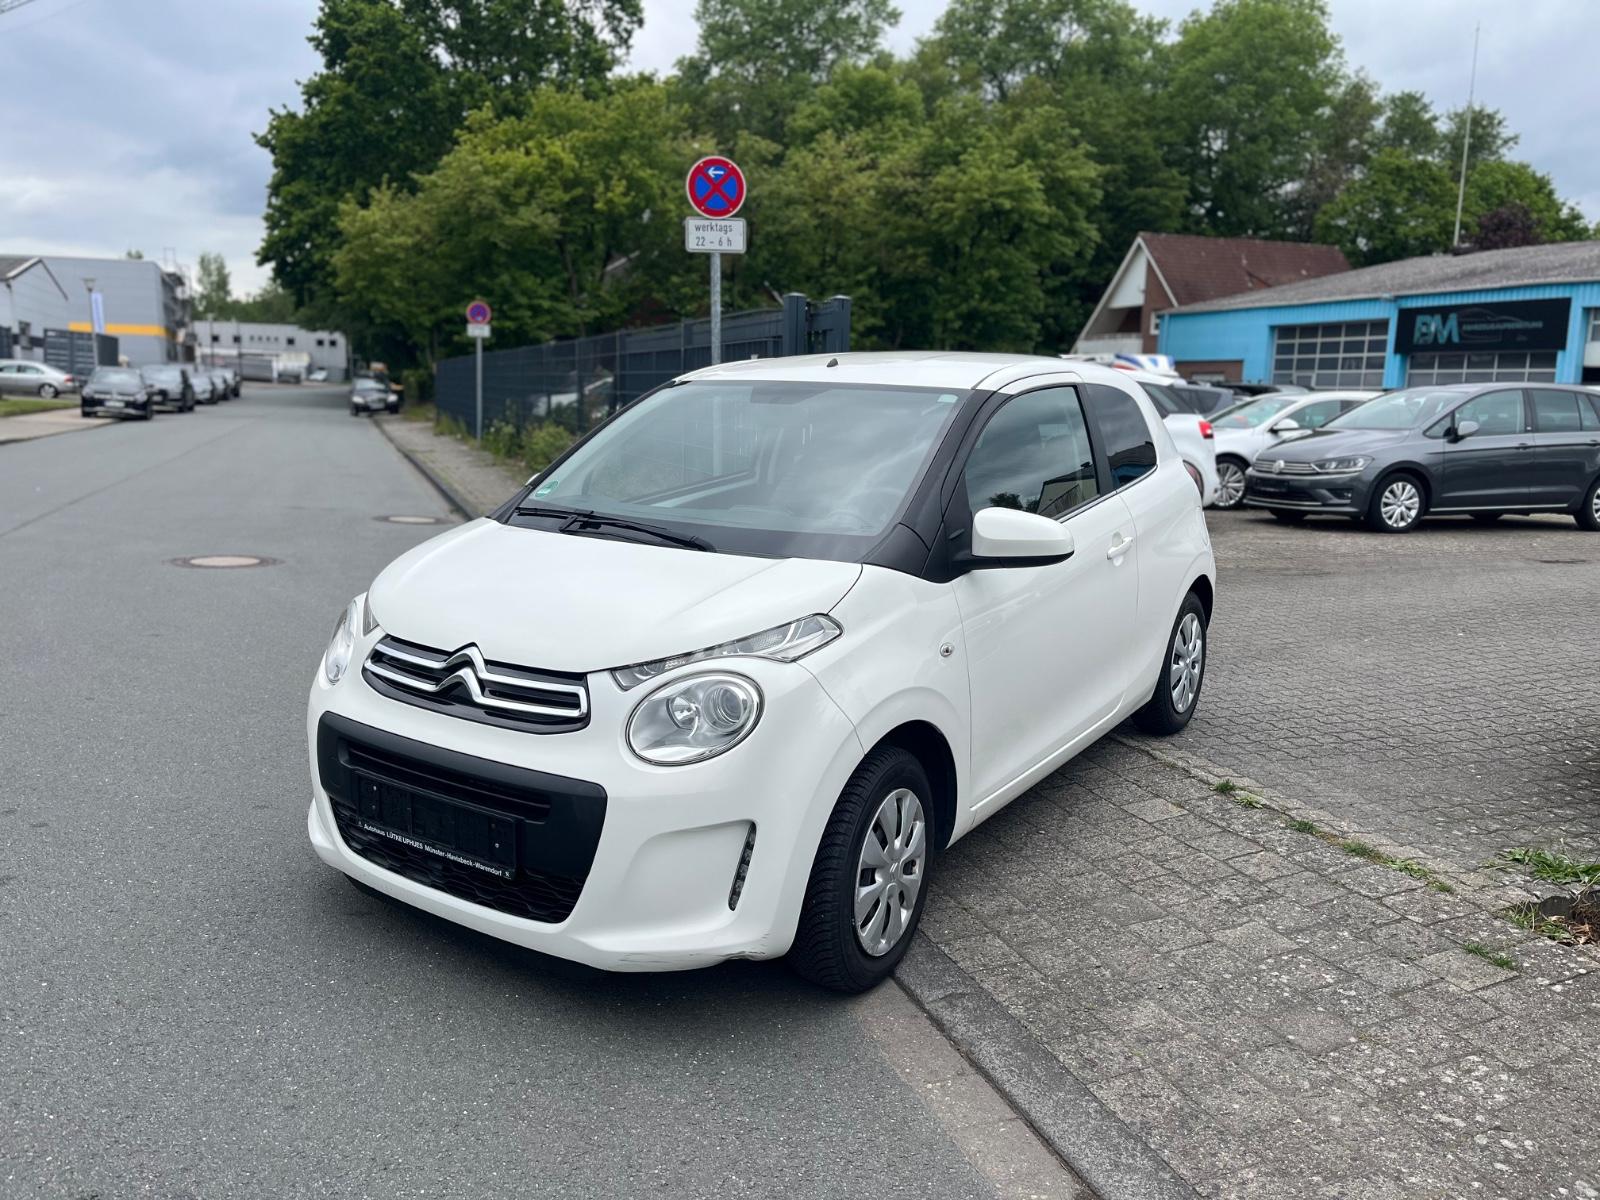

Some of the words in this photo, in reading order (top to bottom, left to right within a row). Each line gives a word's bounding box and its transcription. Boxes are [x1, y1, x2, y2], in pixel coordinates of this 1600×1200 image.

[694, 222, 733, 235] werktags
[695, 236, 706, 247] 22
[718, 236, 724, 247] 6
[726, 236, 732, 247] h
[363, 823, 386, 837] Autohaus
